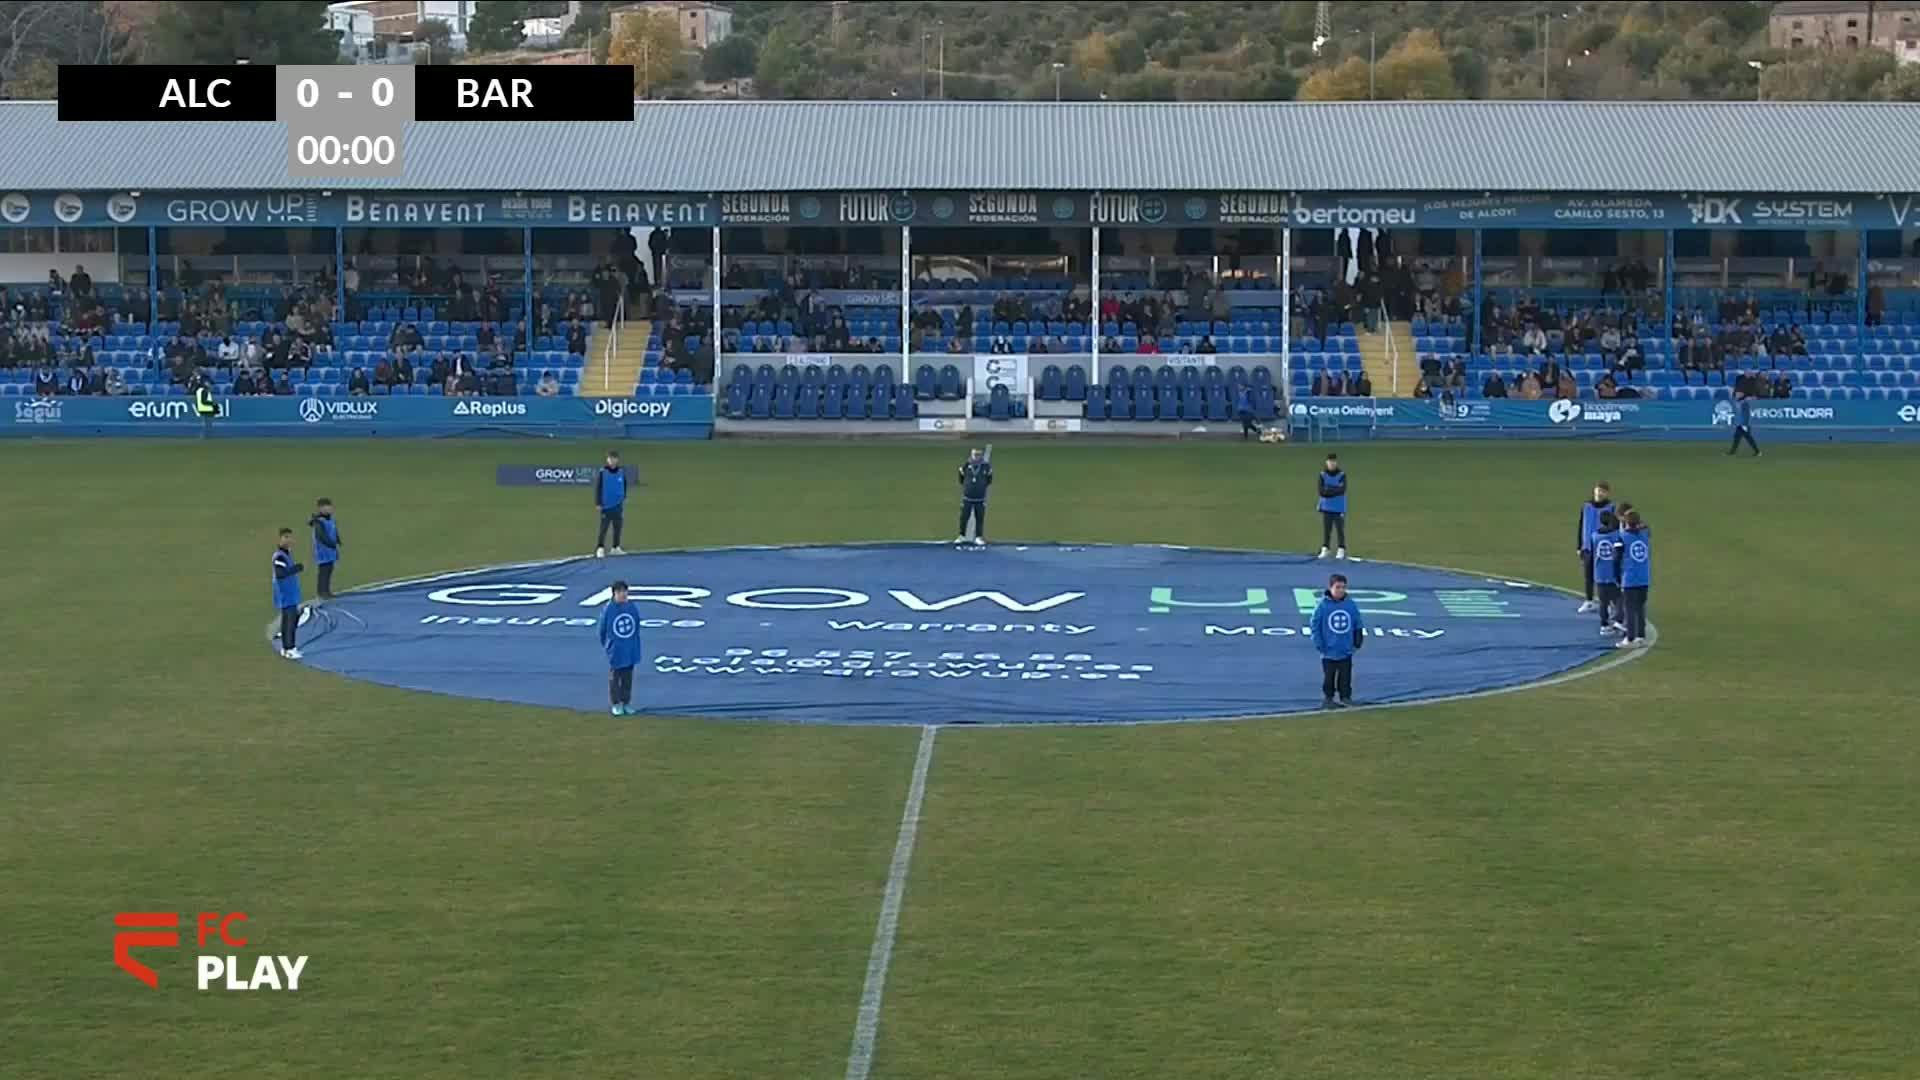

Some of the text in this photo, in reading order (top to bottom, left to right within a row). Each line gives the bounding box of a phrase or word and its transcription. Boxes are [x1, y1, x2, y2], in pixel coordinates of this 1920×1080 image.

[167, 200, 259, 222] GROW
[722, 194, 790, 213] SEGUNDA
[969, 194, 1037, 213] SEGUNDA
[1220, 194, 1288, 213] SEGUNDA
[1294, 196, 1415, 223] bertomeu
[1752, 201, 1852, 217] SYSTEM
[1554, 209, 1603, 218] CAMILO
[128, 401, 188, 418] erum
[328, 402, 377, 413] VIDLUX
[471, 401, 526, 416] Replus
[595, 401, 670, 417] Digicopy
[1584, 411, 1621, 423] maya
[536, 469, 574, 478] GROW
[428, 583, 1087, 612] GROW
[420, 614, 705, 628] Insurace
[827, 620, 1096, 635] Warranty
